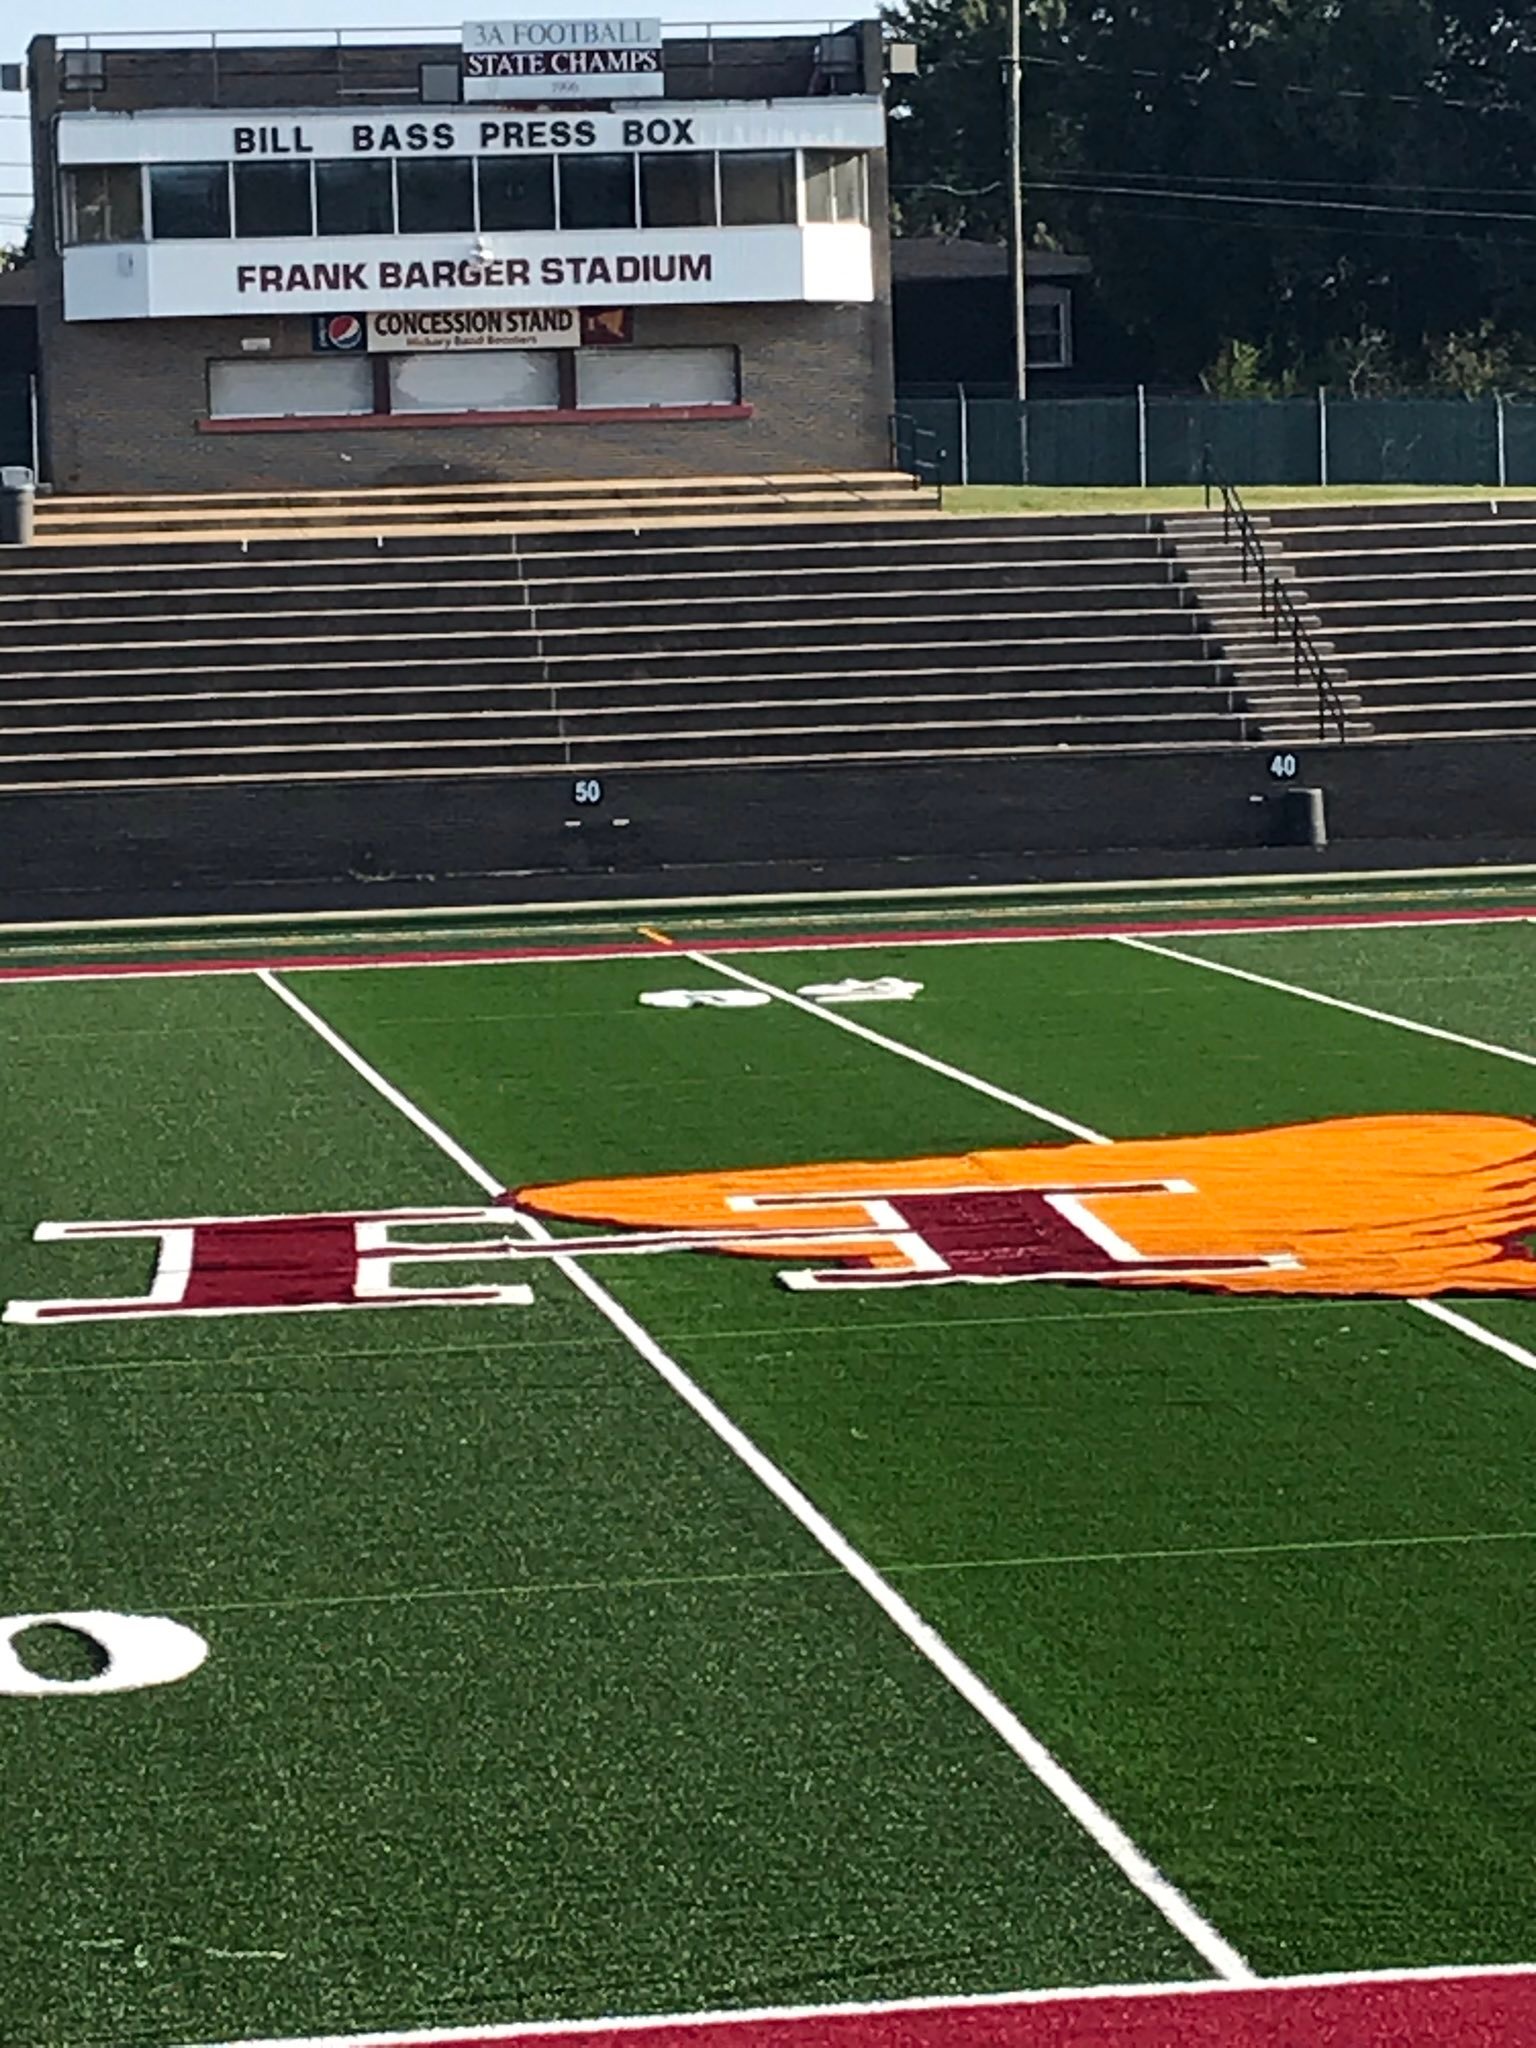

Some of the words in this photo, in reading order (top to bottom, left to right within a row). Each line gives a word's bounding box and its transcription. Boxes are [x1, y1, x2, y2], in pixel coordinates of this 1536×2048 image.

[474, 23, 505, 46] 3A
[512, 21, 651, 46] FOOTBALL
[468, 54, 546, 76] STATE
[551, 50, 657, 74] CHAMPS
[234, 126, 313, 154] BILL
[352, 123, 455, 151] BASS
[480, 119, 596, 149] PRESS
[622, 118, 695, 146] BOX
[237, 262, 369, 293] FRANK
[379, 258, 530, 288] BARGER
[541, 253, 712, 284] STADIUM
[374, 310, 501, 336] CONCESSION
[506, 308, 573, 333] STAND
[1270, 753, 1296, 778] 40
[575, 780, 600, 803] 50
